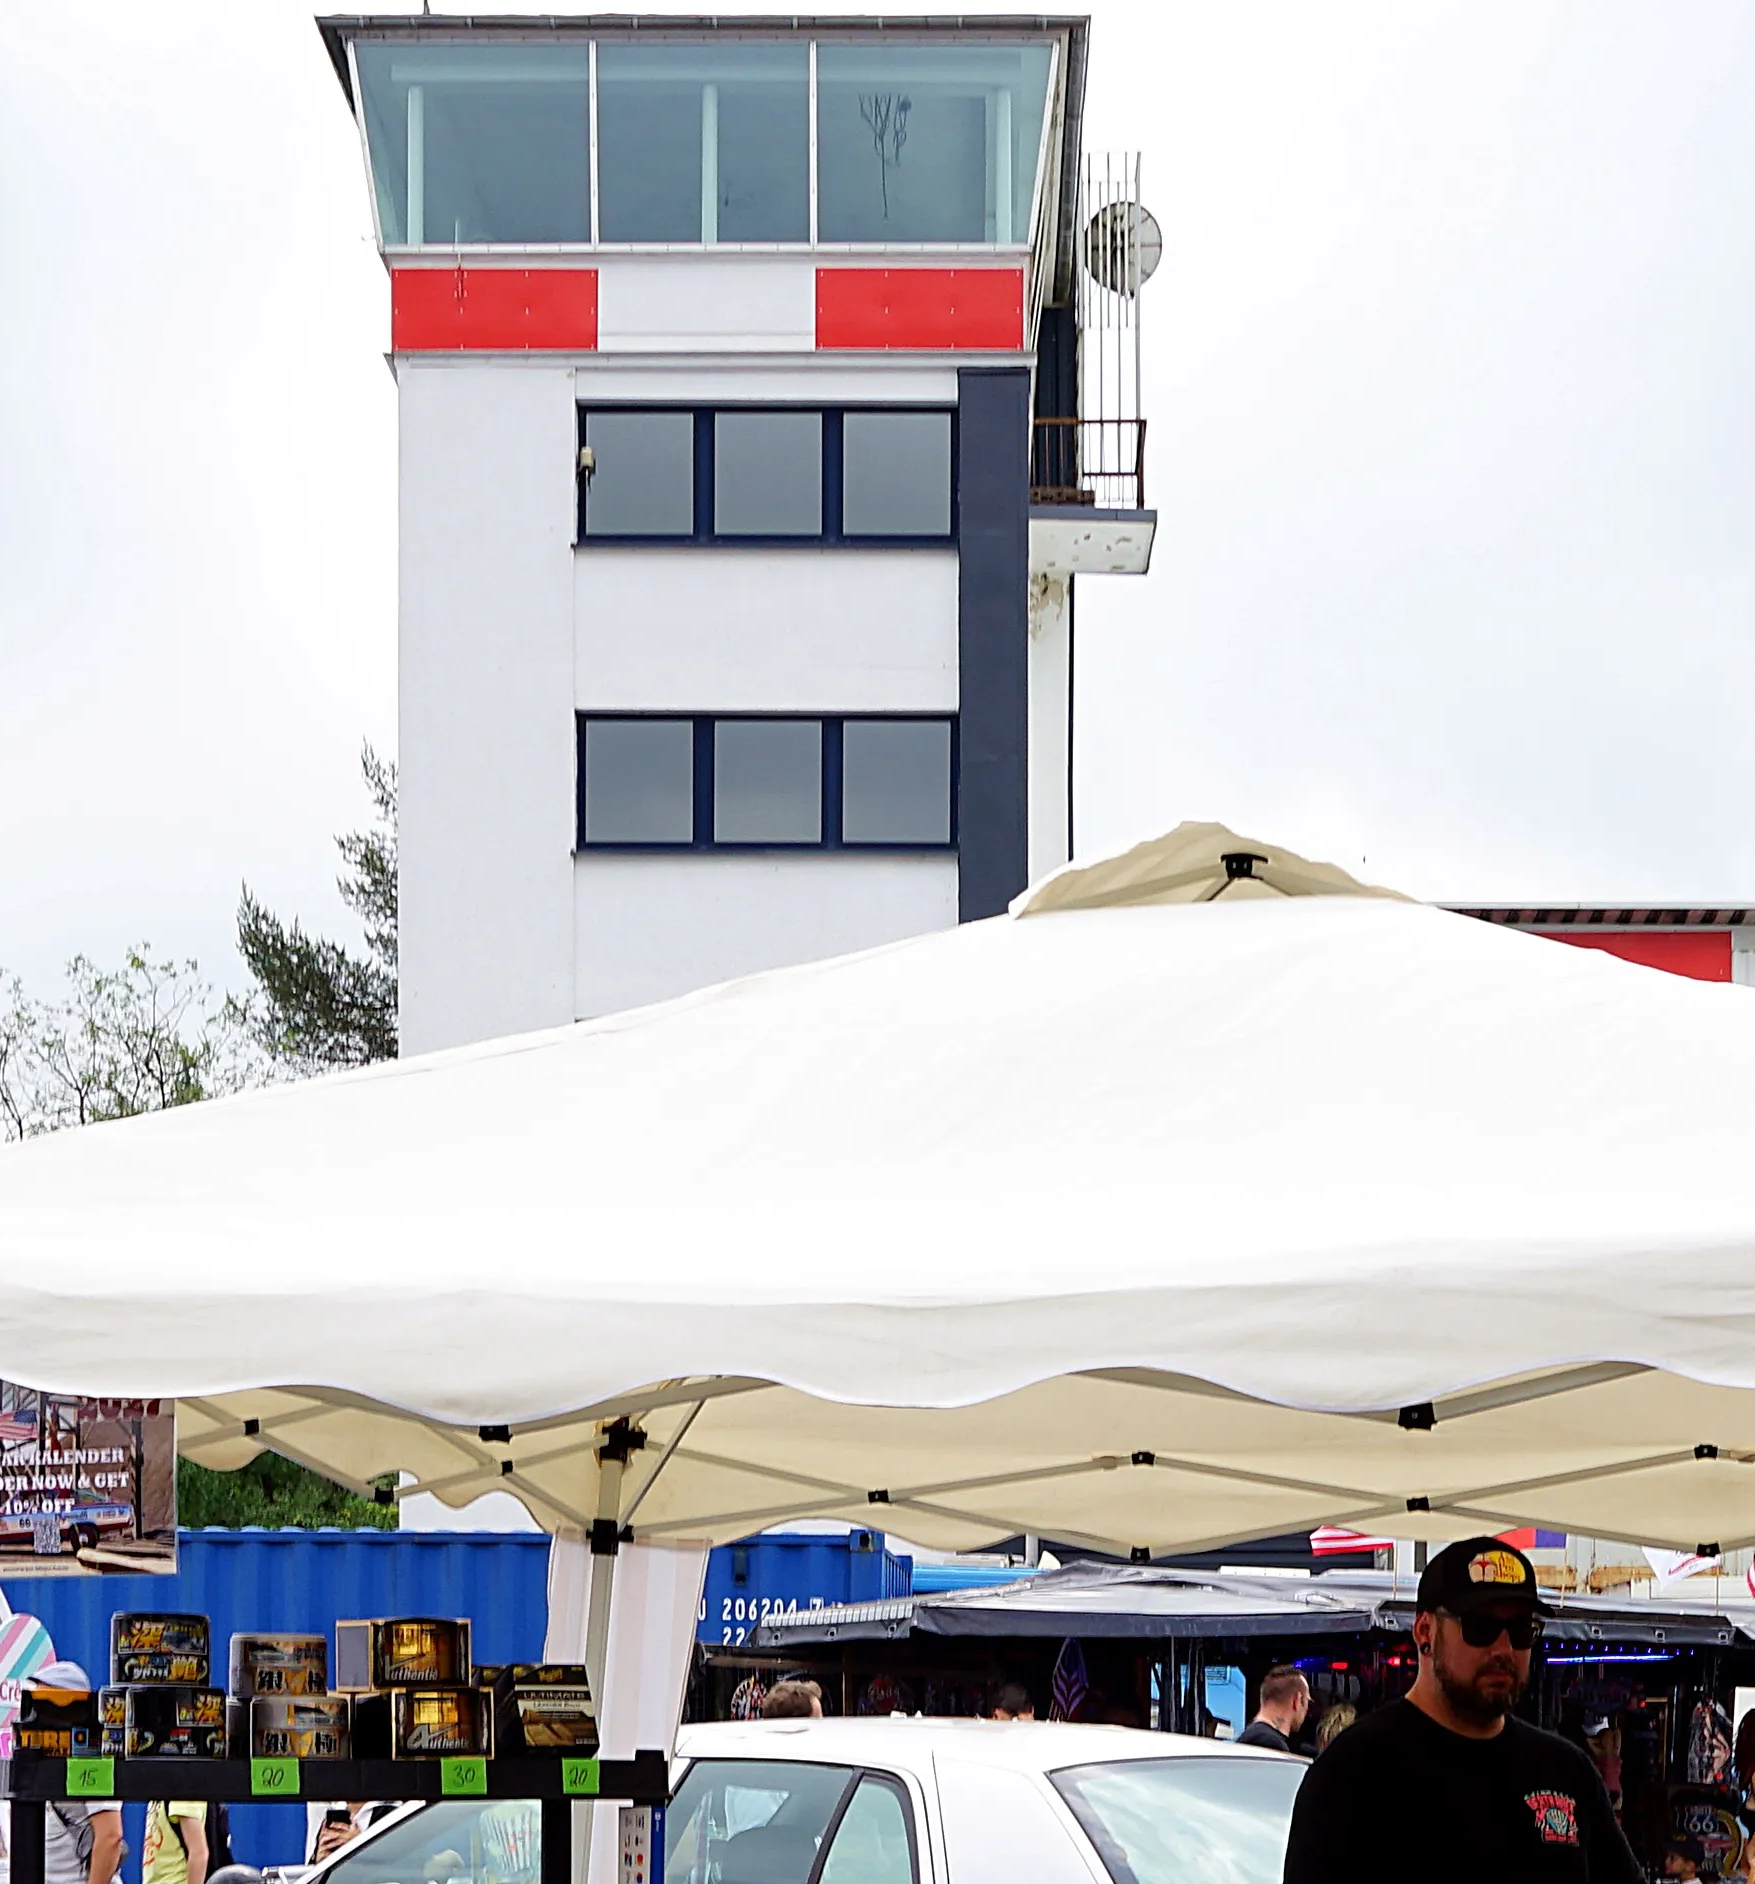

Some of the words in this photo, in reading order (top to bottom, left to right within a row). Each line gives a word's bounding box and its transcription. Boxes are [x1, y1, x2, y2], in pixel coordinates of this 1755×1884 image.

[28, 1447, 125, 1467] KALENDER
[32, 1473, 74, 1491] NOW
[78, 1473, 91, 1488] &
[94, 1471, 131, 1488] GET
[3, 1499, 38, 1516] 10%
[41, 1498, 76, 1514] OFF
[722, 1626, 746, 1647] 22
[79, 1768, 99, 1788] 15
[261, 1769, 285, 1788] 20
[453, 1765, 476, 1787] 30
